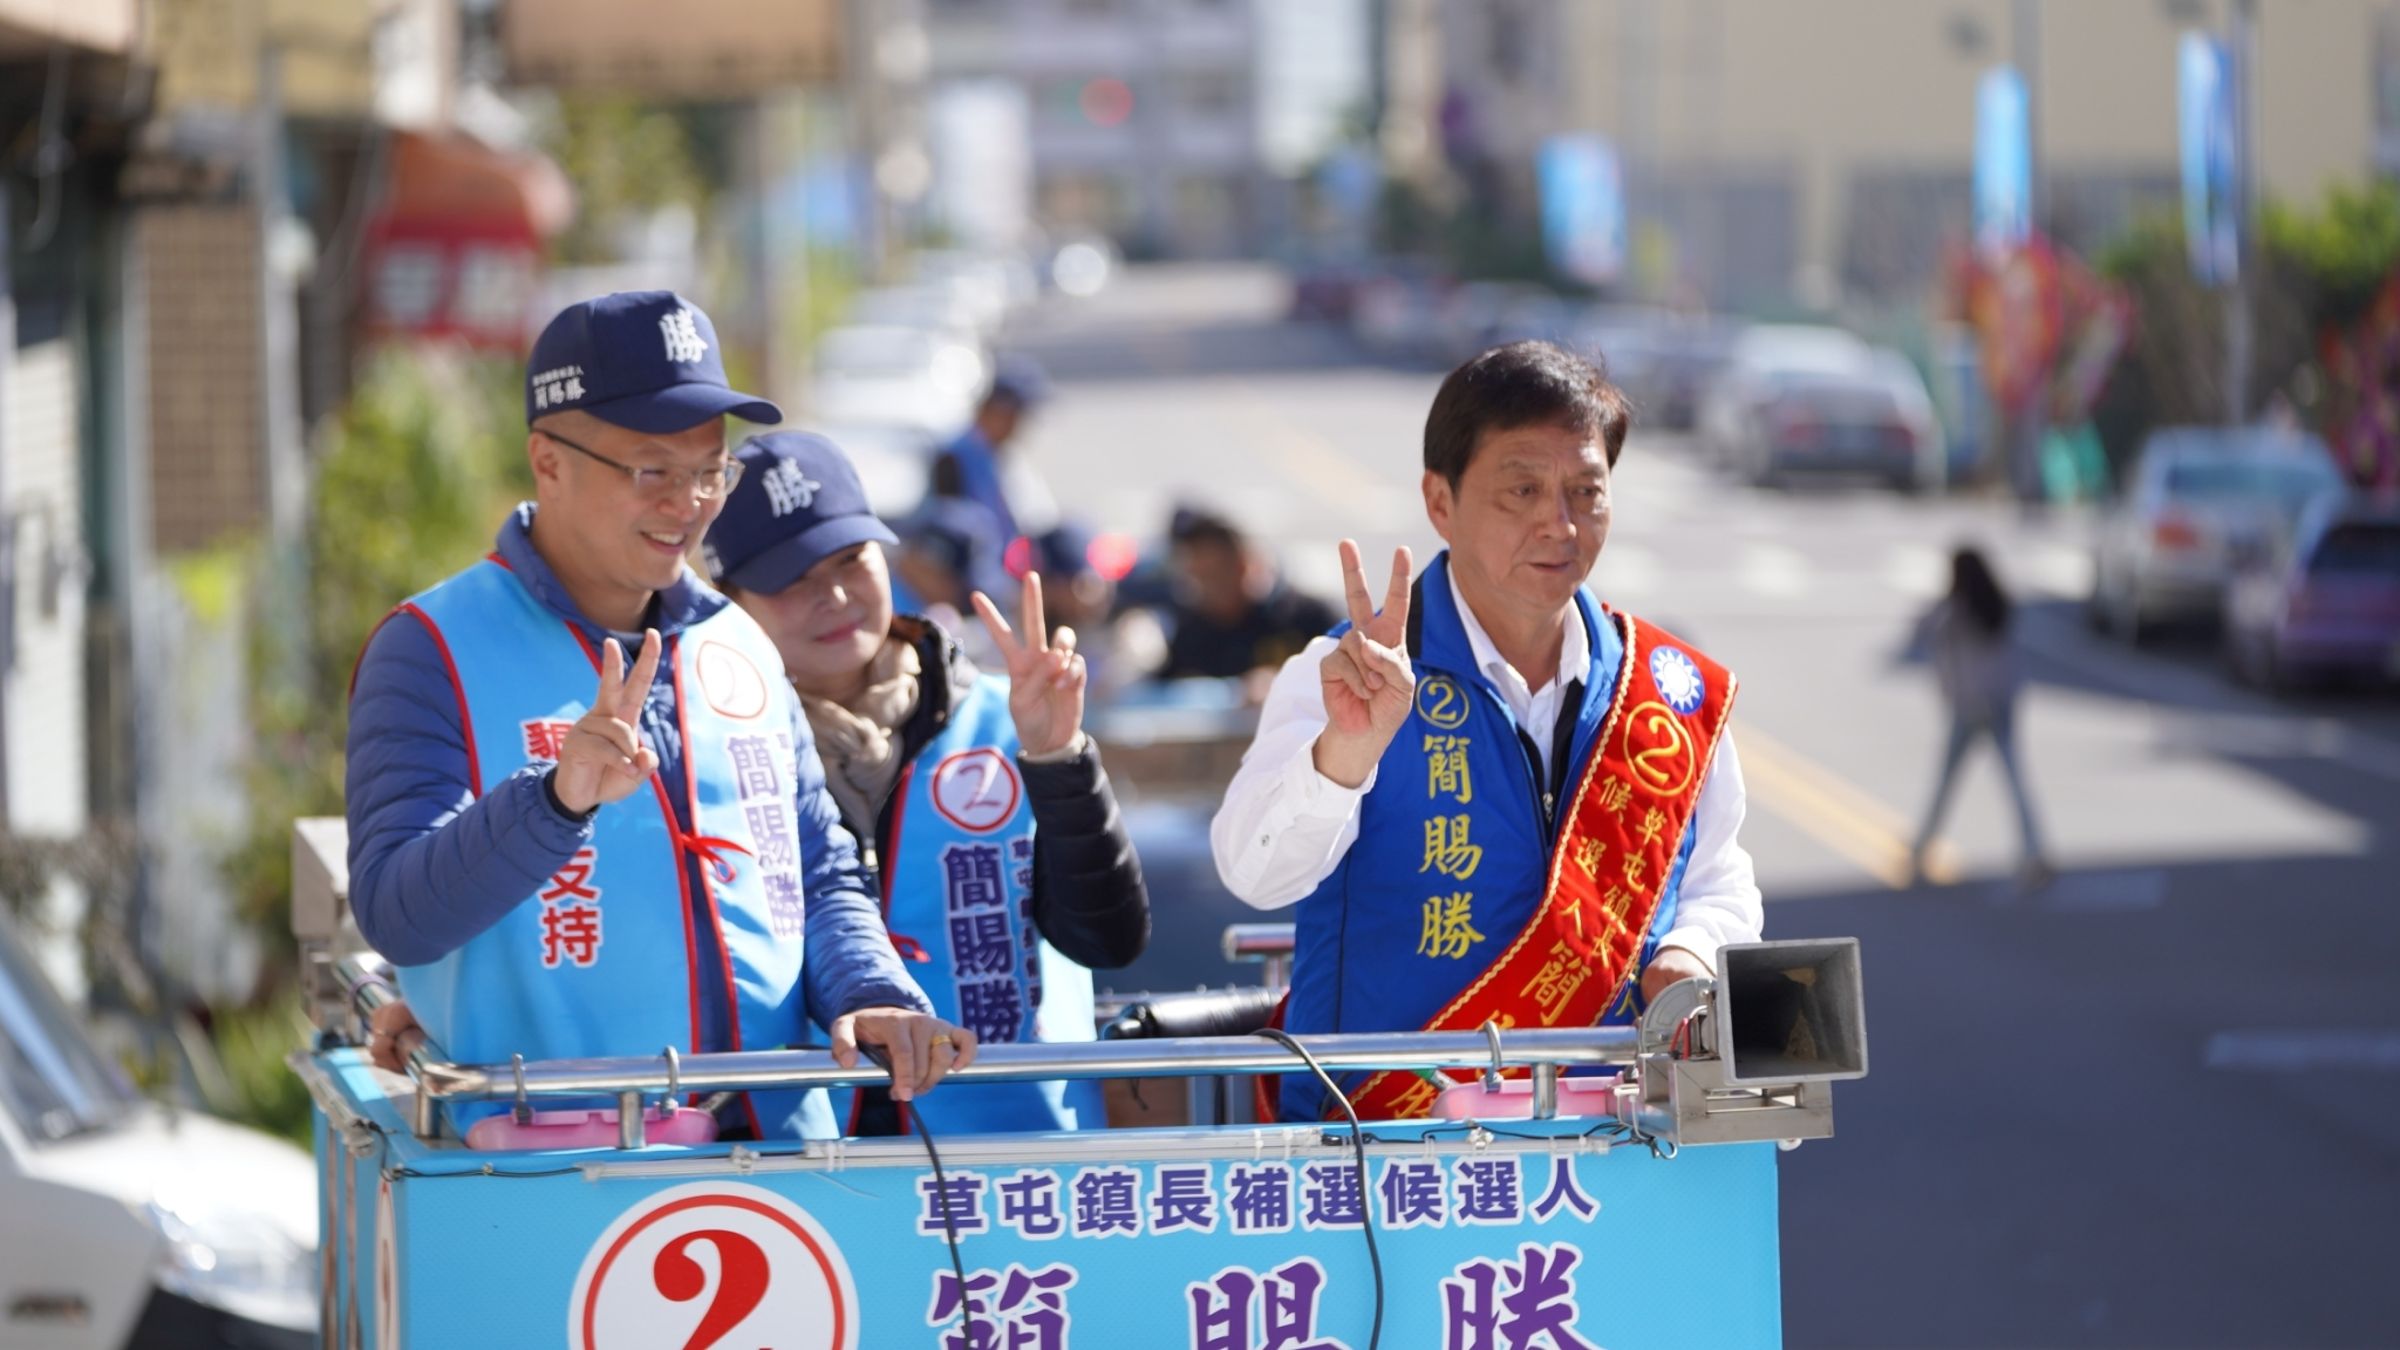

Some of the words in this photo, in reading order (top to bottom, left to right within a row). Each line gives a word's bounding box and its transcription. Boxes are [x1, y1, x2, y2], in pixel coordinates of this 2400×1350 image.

[659, 308, 708, 363] 勝
[761, 457, 821, 518] 勝
[1416, 734, 1487, 960] 簡賜勝
[943, 843, 1024, 1044] 簡賜勝
[922, 1158, 1595, 1238] 草屯鎮長補選候選人
